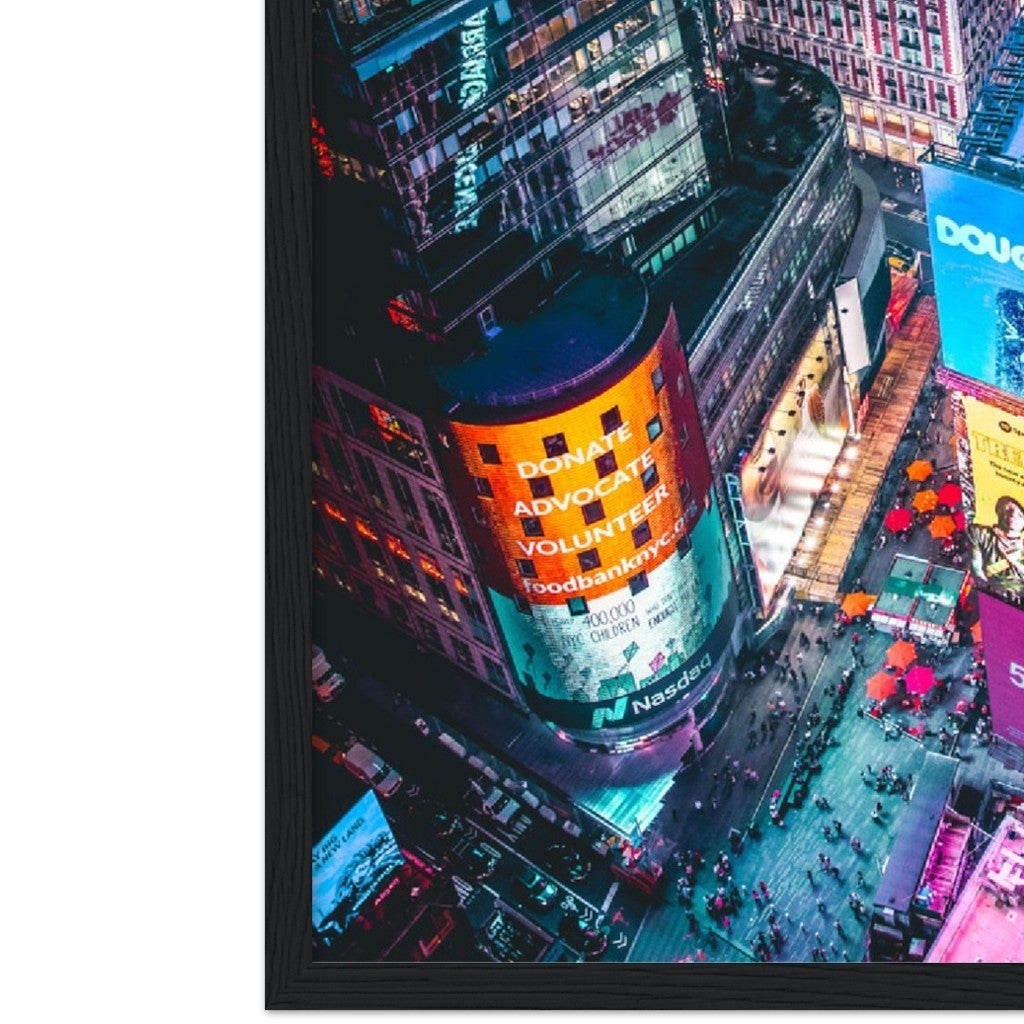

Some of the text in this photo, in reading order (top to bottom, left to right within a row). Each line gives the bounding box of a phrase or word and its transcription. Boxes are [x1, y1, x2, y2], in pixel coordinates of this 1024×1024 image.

[517, 421, 633, 479] DONATE
[514, 447, 655, 516] ADVOCATE
[517, 484, 670, 557] VOLUNTEER
[562, 616, 641, 647] NYC CHILDREN
[631, 653, 712, 715] Nasdaq
